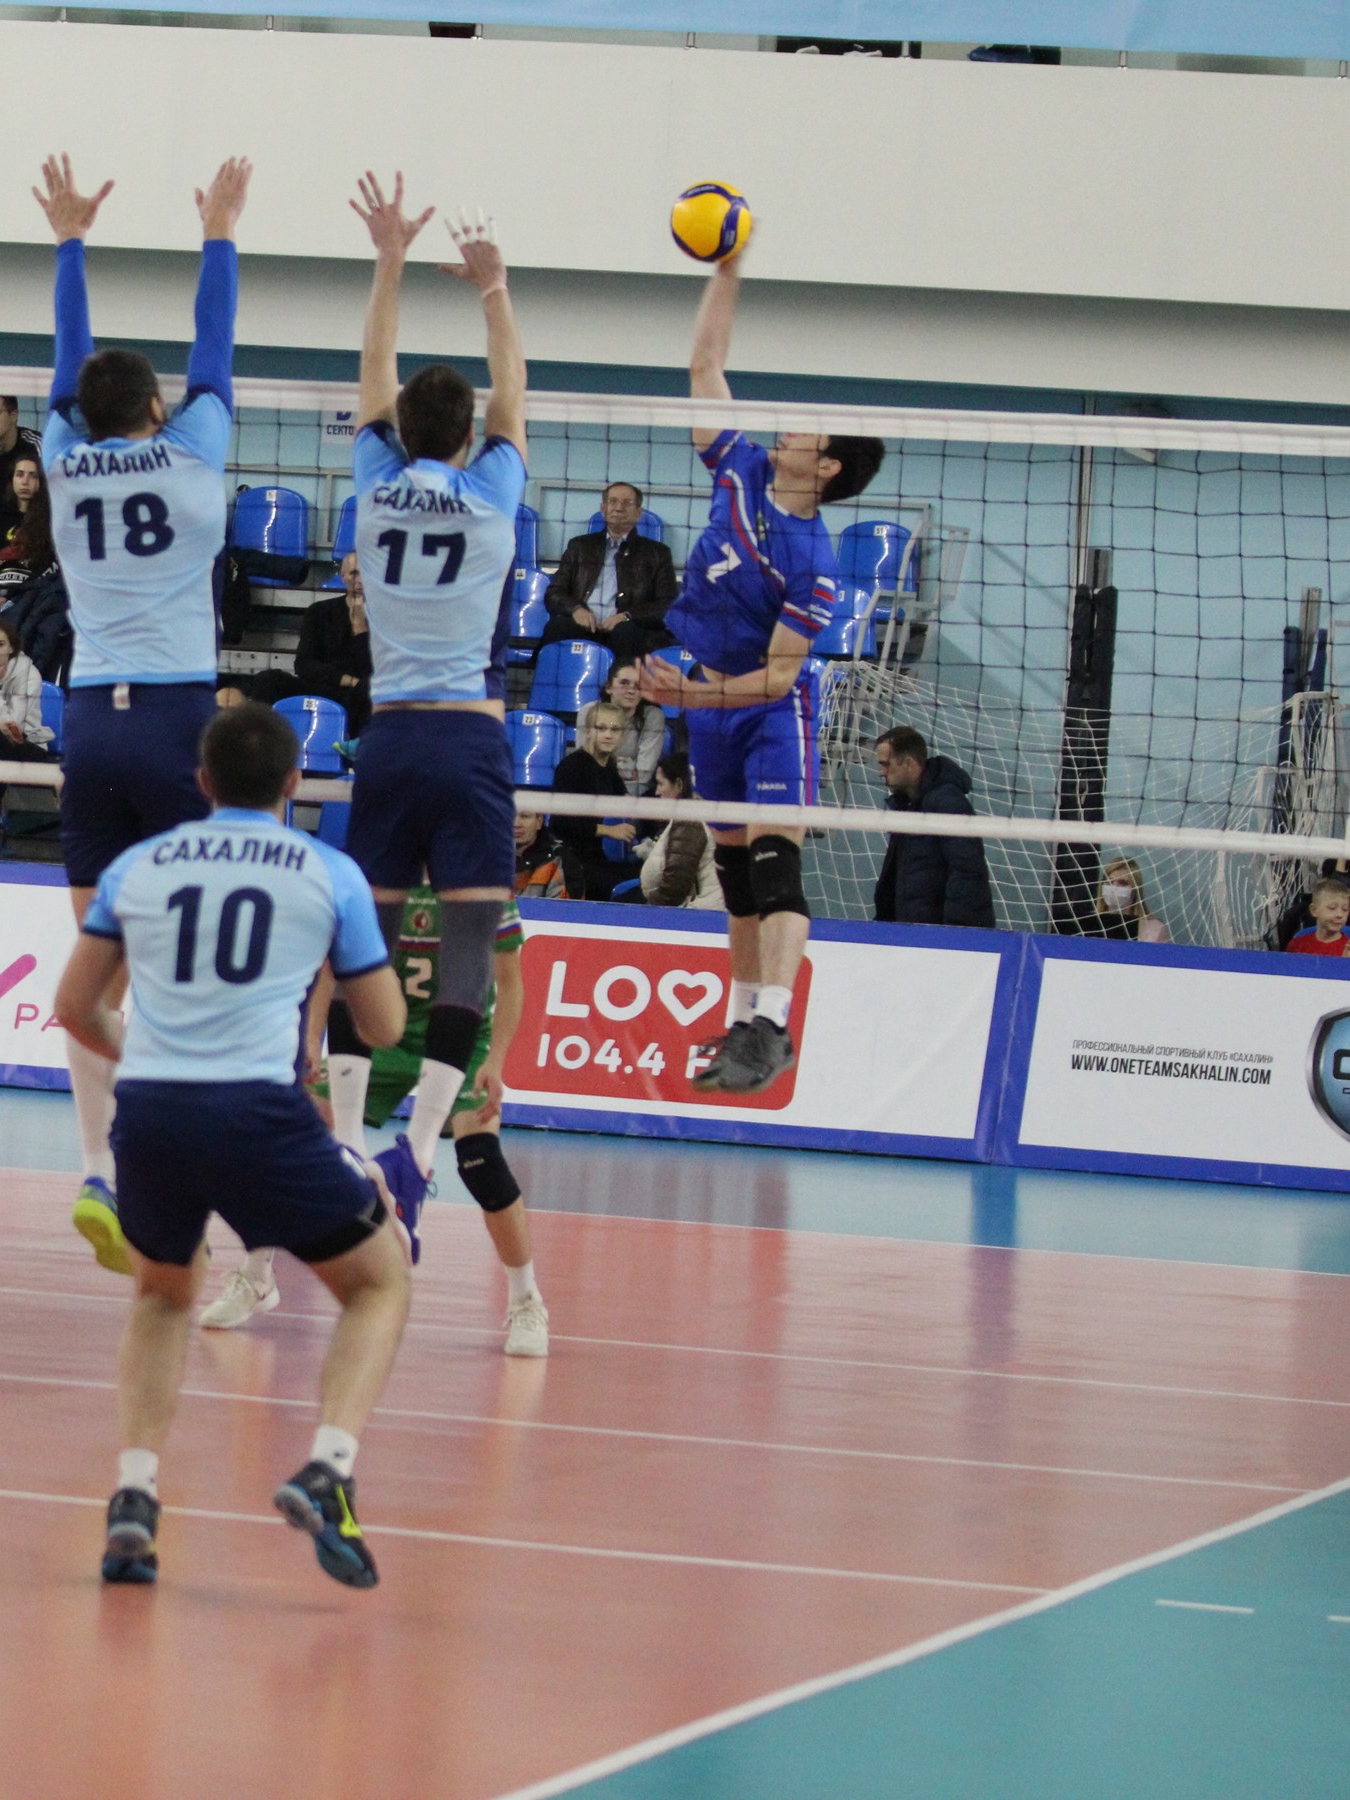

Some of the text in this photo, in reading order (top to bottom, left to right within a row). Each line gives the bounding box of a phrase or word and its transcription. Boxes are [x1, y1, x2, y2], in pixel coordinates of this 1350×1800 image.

[326, 424, 355, 436] СЕКТО
[62, 444, 172, 478] САХАЛИН
[75, 491, 175, 560] 18
[378, 528, 467, 585] 17
[153, 838, 307, 871] САХАЛИН
[167, 885, 275, 985] 10
[405, 957, 433, 999] 2
[537, 1033, 717, 1079] 104.4 F
[1072, 1039, 1154, 1055] ПРОФЕССИОНАЛЬНЫЙ
[1155, 1045, 1206, 1059] СПОРТИВНЫЙ
[1207, 1050, 1228, 1061] КЛУБ
[1071, 1054, 1272, 1085] WWW.ONETEAMSAKHALIN.COM
